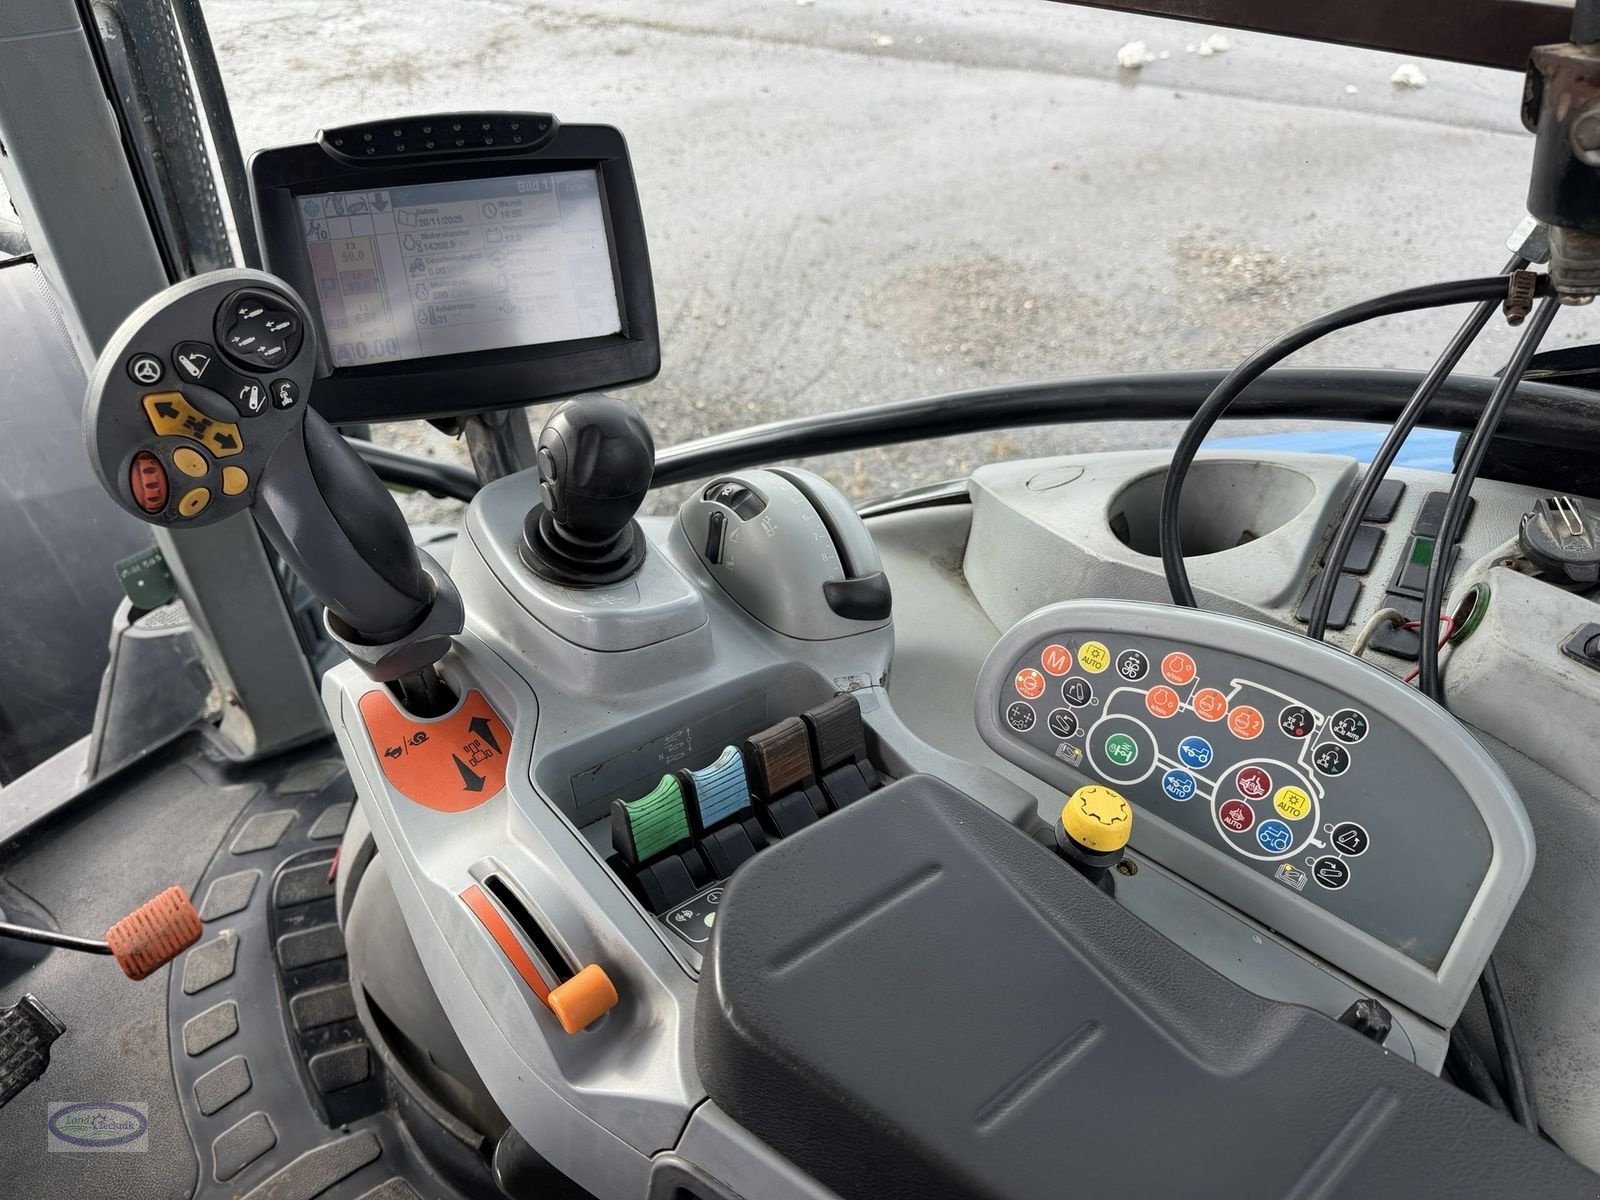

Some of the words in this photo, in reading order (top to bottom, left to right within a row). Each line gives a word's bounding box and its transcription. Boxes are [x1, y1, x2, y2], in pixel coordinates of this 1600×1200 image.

[517, 178, 540, 193] Bild
[542, 178, 549, 191] 1
[417, 214, 463, 227] 20/11/2025
[315, 230, 328, 241] 10
[342, 250, 365, 263] 50.0
[427, 266, 446, 275] 0.00
[320, 277, 337, 299] P
[435, 315, 448, 324] 31
[355, 337, 398, 360] 0.00
[721, 487, 732, 496] 10
[811, 532, 819, 541] 7
[1047, 651, 1066, 671] M
[1081, 655, 1102, 670] AUTO
[1216, 703, 1223, 712] 1
[1252, 720, 1260, 730] 2
[1346, 731, 1360, 741] AUTO
[1166, 784, 1186, 799] AUTO
[1277, 801, 1301, 817] AUTO
[1223, 816, 1243, 830] AUTO
